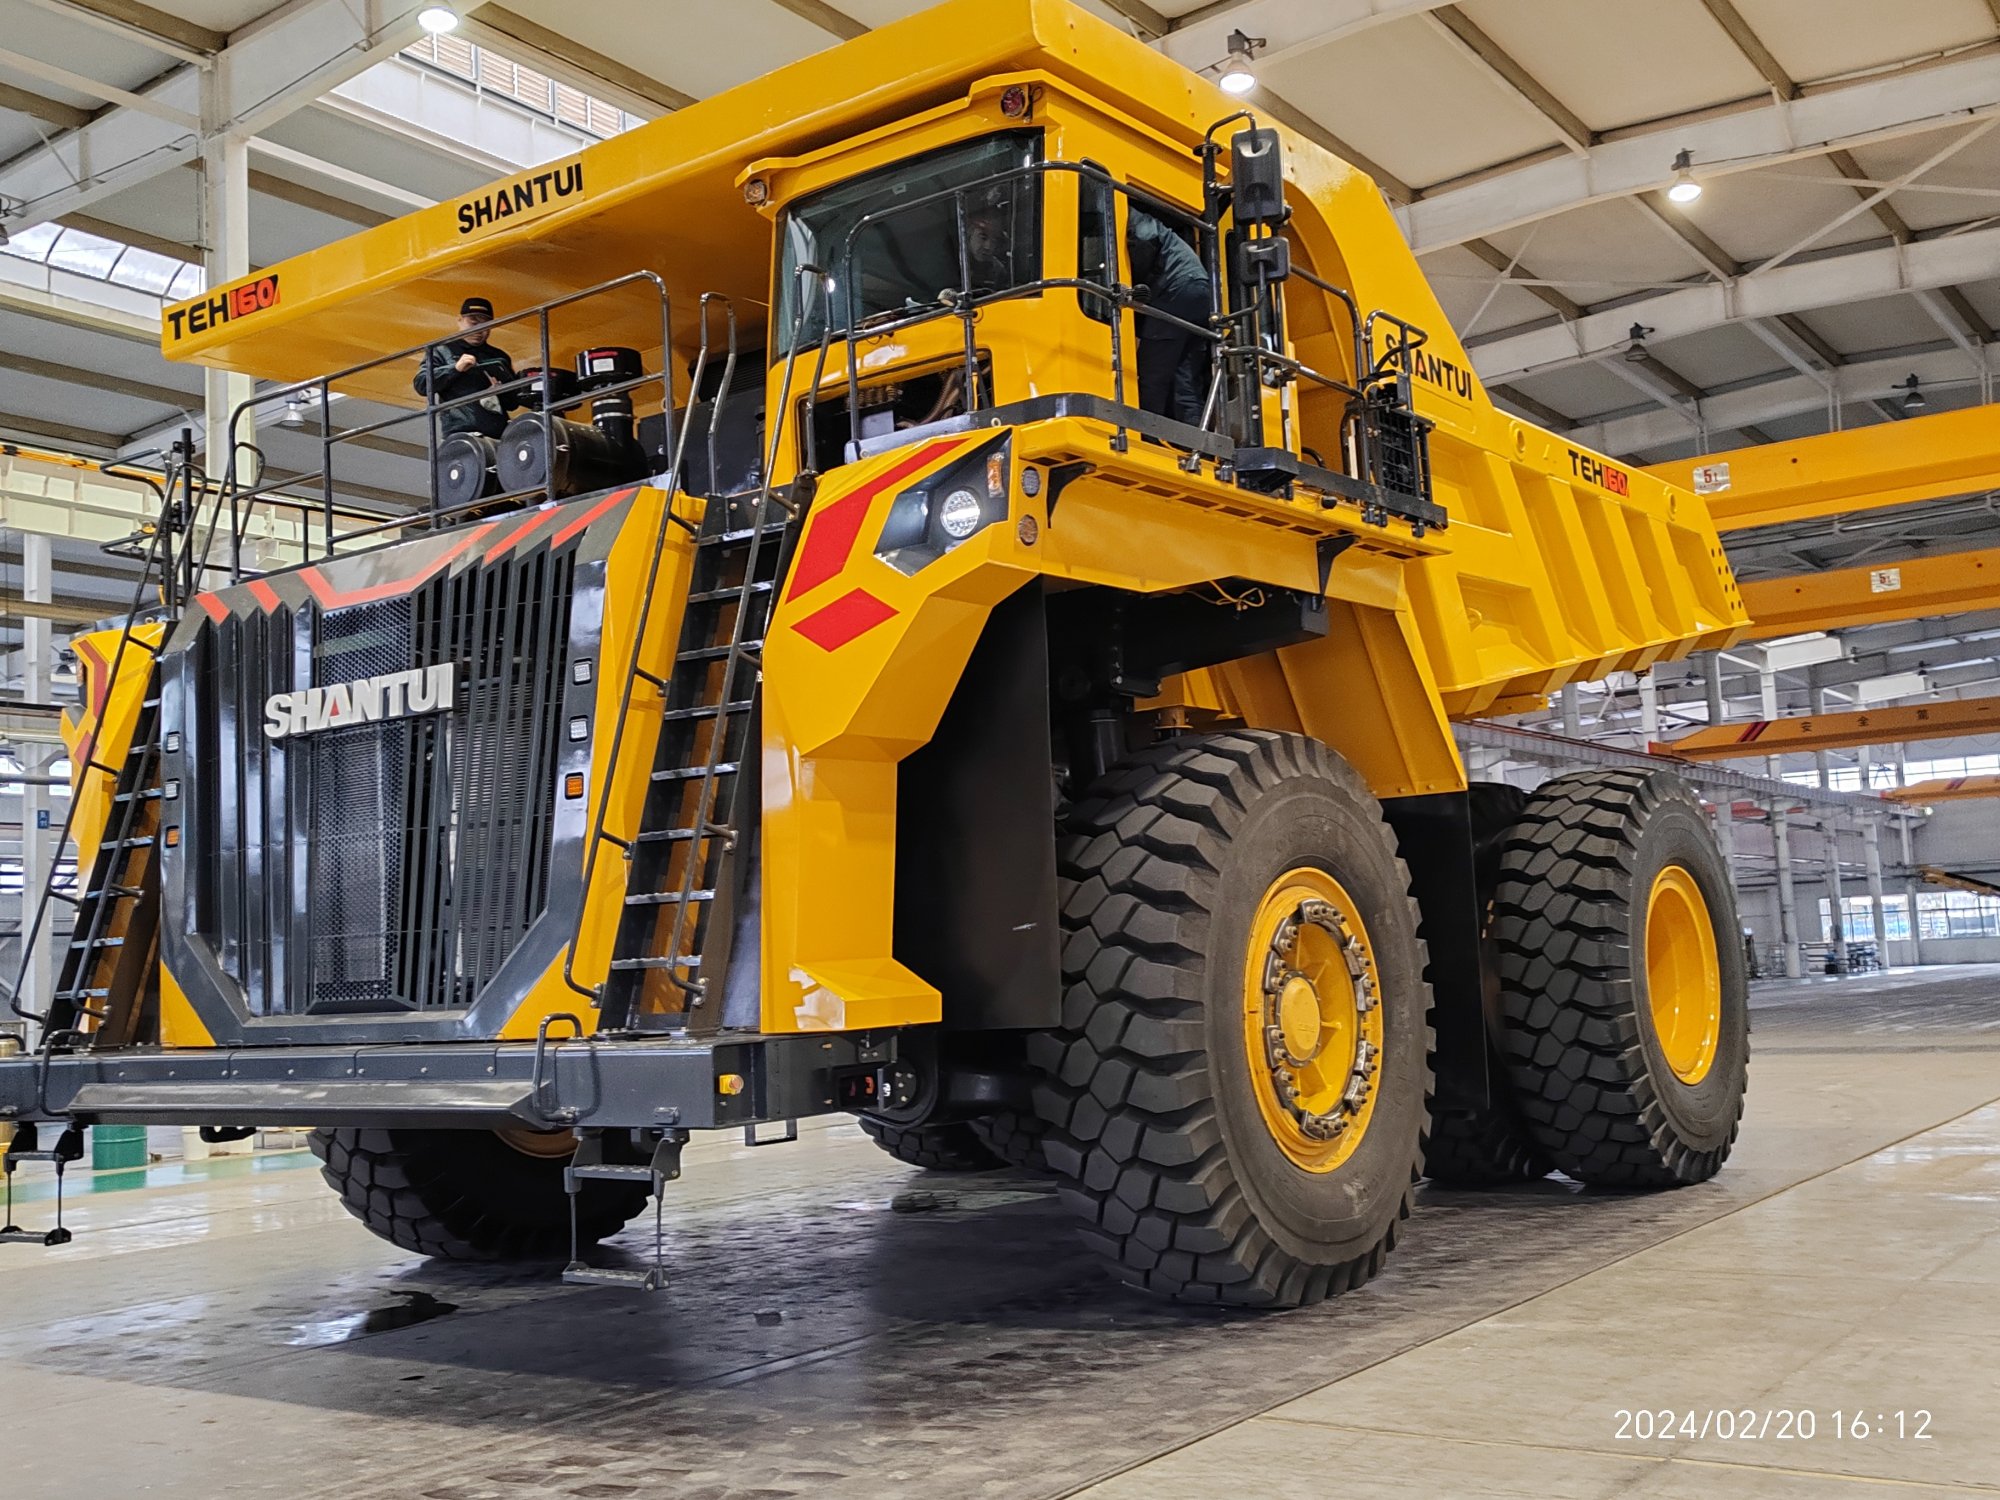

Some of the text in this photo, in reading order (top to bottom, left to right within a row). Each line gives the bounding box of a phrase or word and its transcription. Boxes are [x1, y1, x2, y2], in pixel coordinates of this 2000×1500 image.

[458, 163, 583, 233] SHANTUI
[168, 276, 278, 341] TEH160
[1386, 334, 1472, 401] SANTUI
[1568, 448, 1628, 496] TEH160
[264, 663, 454, 738] SHANTUI
